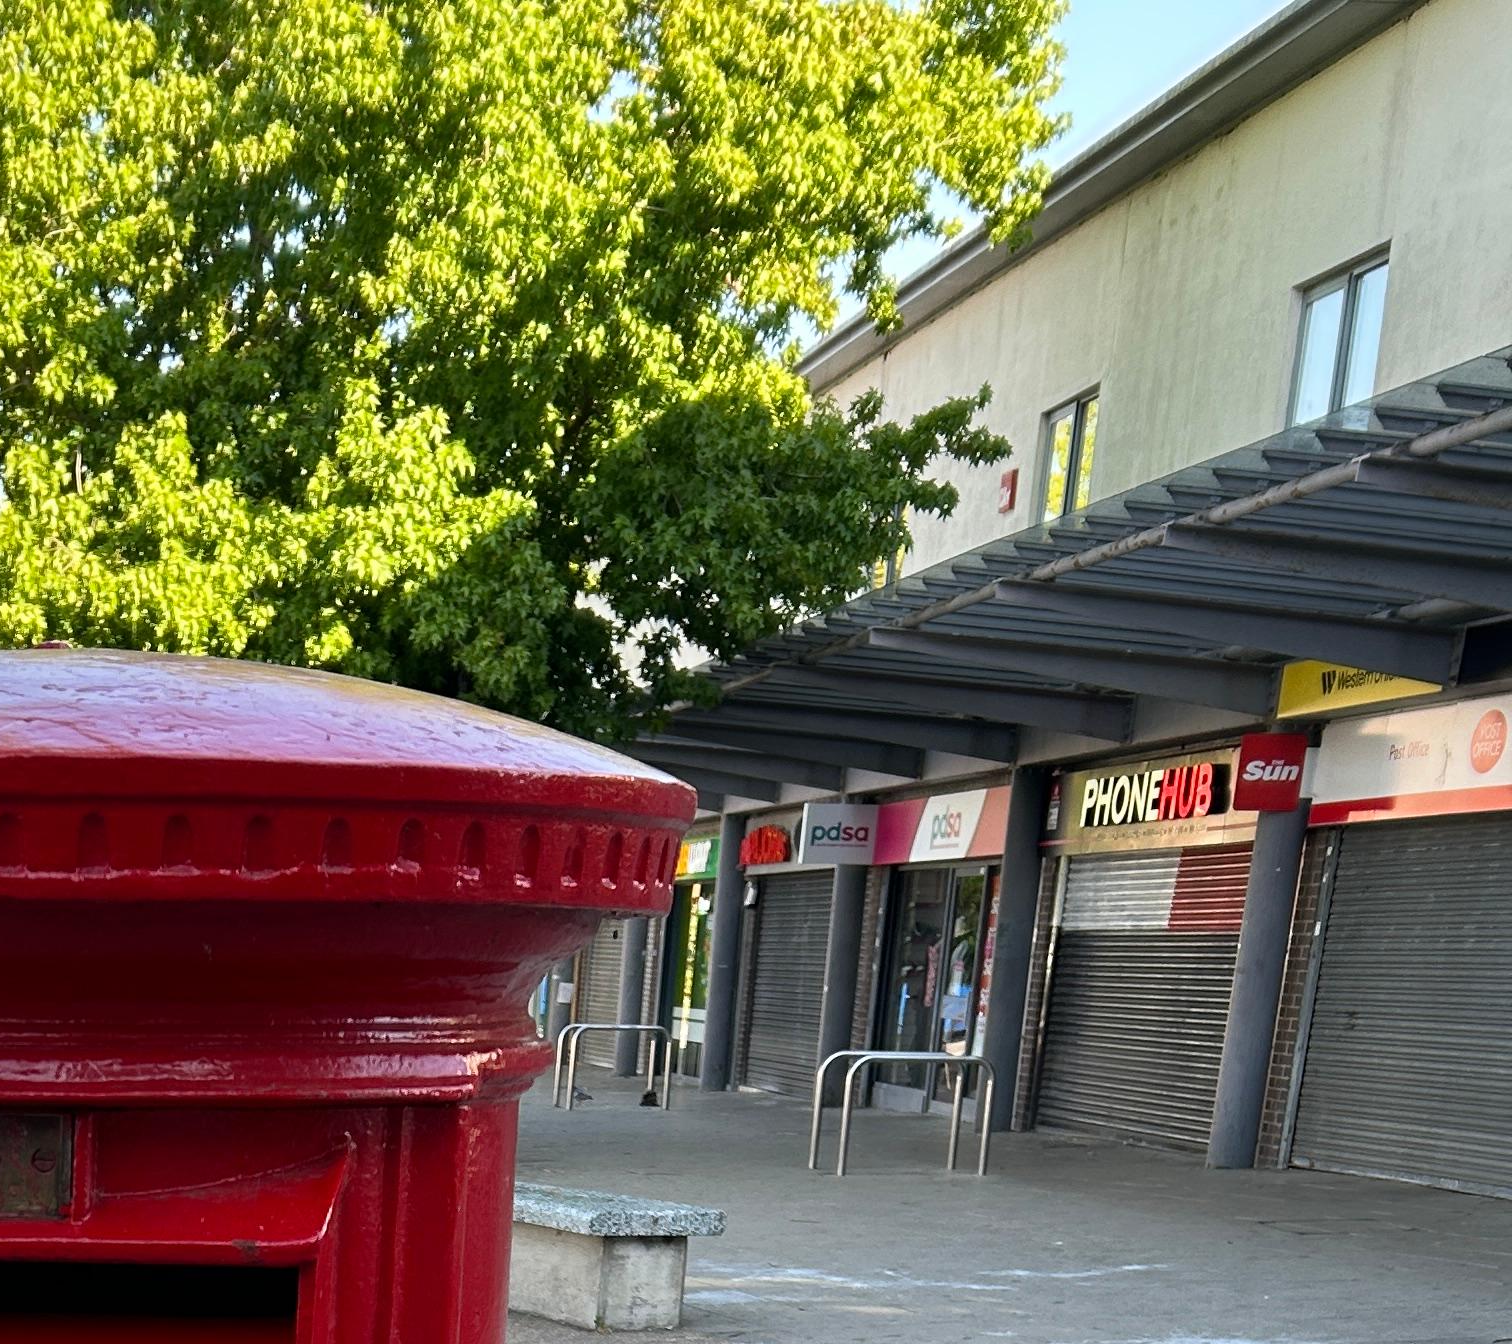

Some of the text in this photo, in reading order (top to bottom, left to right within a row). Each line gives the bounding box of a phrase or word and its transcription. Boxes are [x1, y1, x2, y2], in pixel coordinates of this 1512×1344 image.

[1473, 740, 1501, 757] OFFICE
[1242, 760, 1299, 782] Sun
[810, 821, 869, 846] pdsa
[931, 805, 962, 841] pdsa
